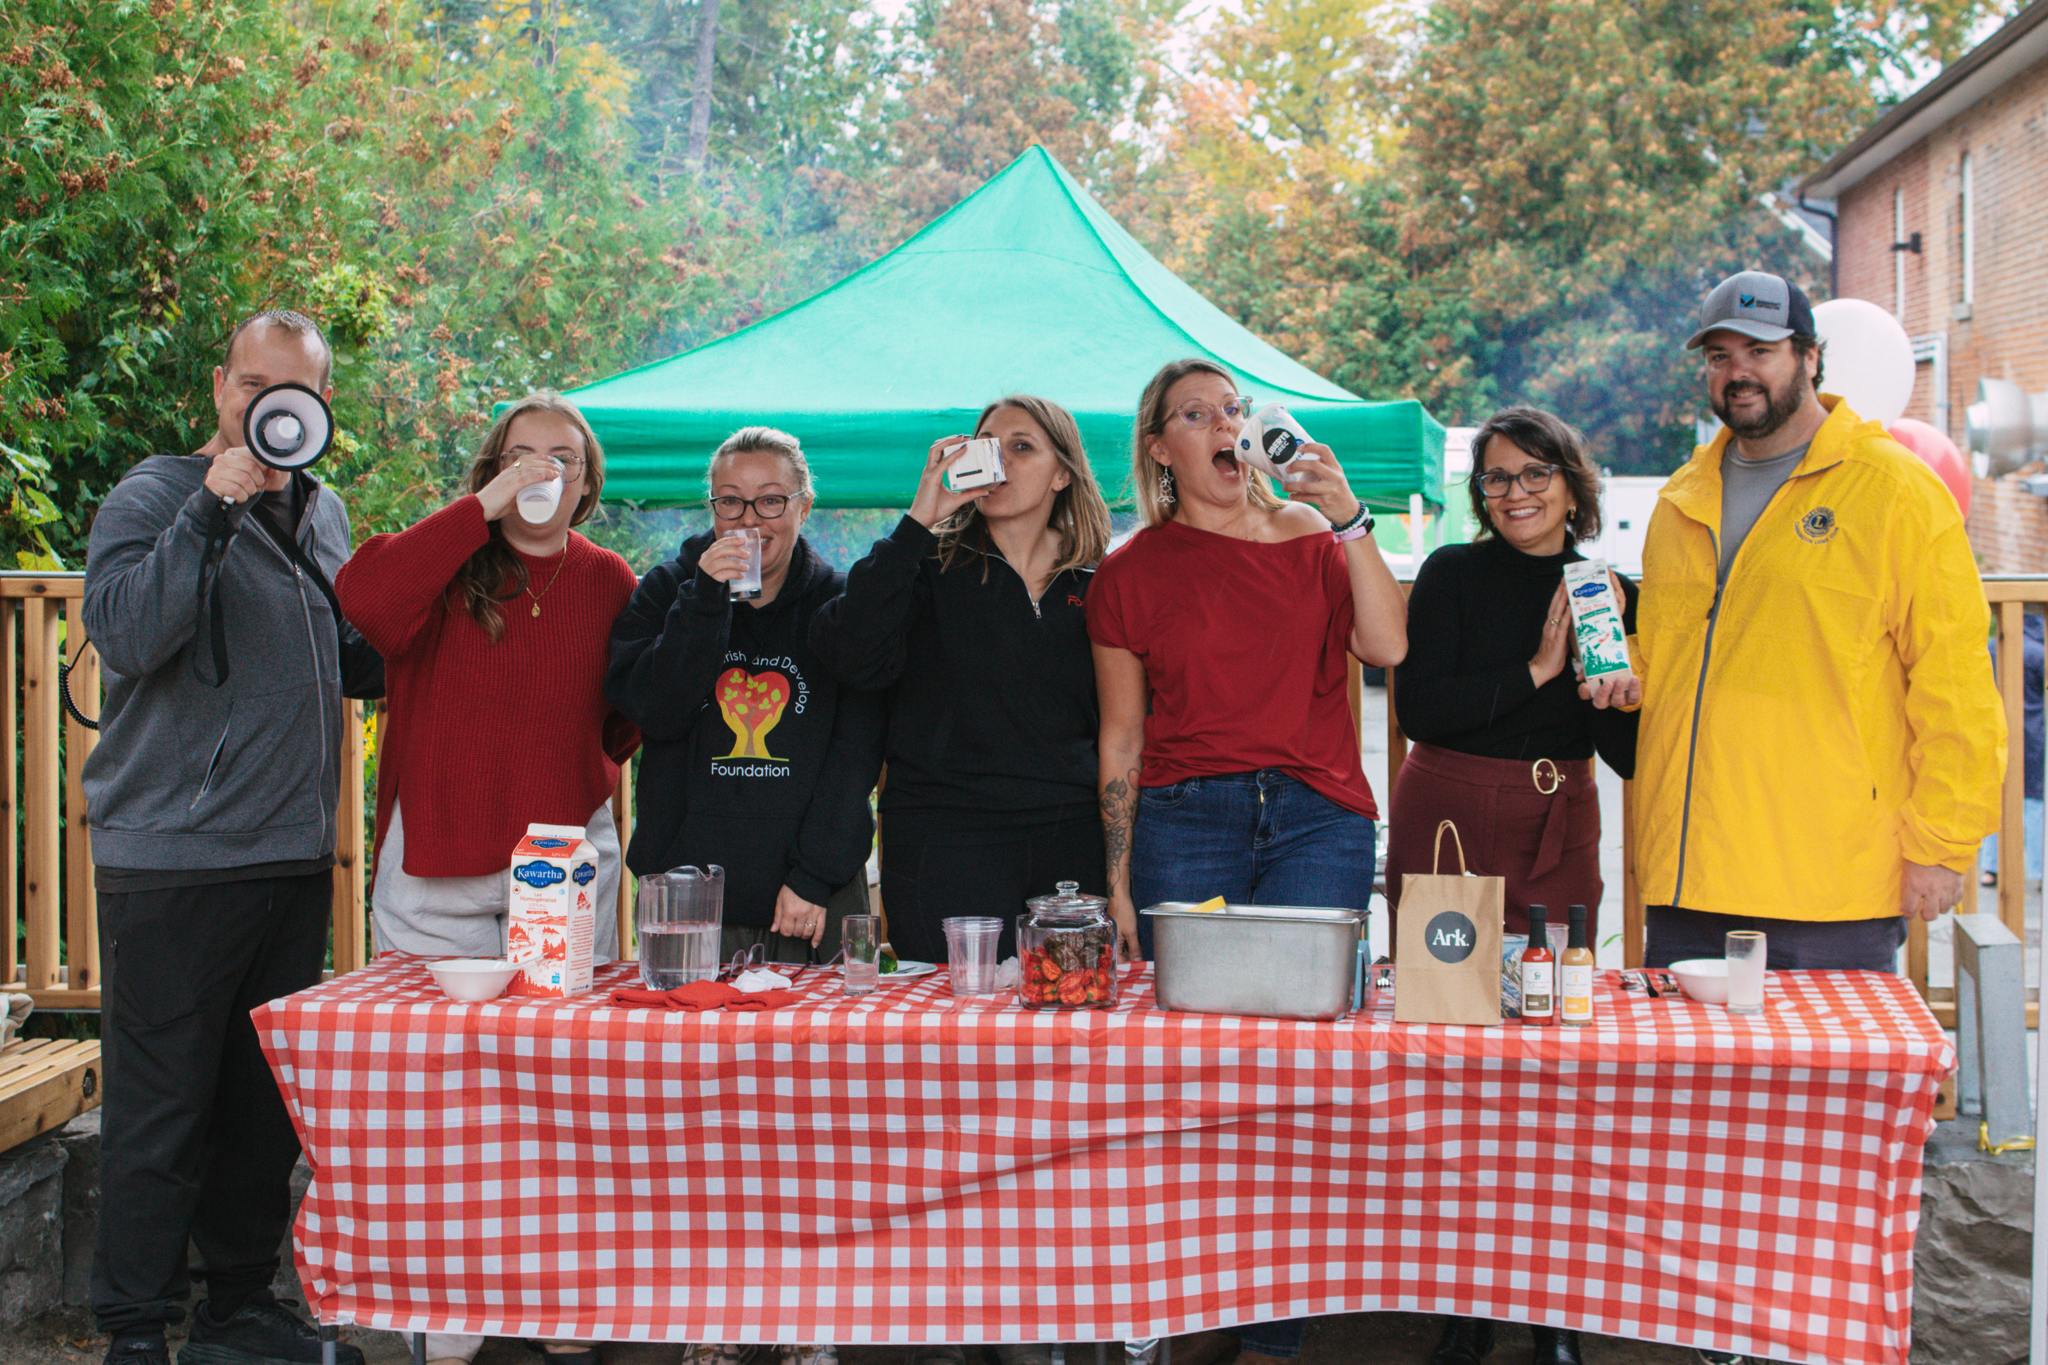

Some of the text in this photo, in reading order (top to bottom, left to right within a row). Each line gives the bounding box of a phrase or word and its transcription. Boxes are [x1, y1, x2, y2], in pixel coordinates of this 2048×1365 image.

[1275, 441, 1290, 457] GREC
[1813, 515, 1824, 528] L
[1574, 584, 1606, 596] Kawartha
[722, 650, 810, 715] rish and Develop
[711, 762, 790, 777] Foundation
[517, 868, 563, 880] Kawartha
[574, 869, 595, 880] Kawartha
[1432, 928, 1470, 947] Ark.
